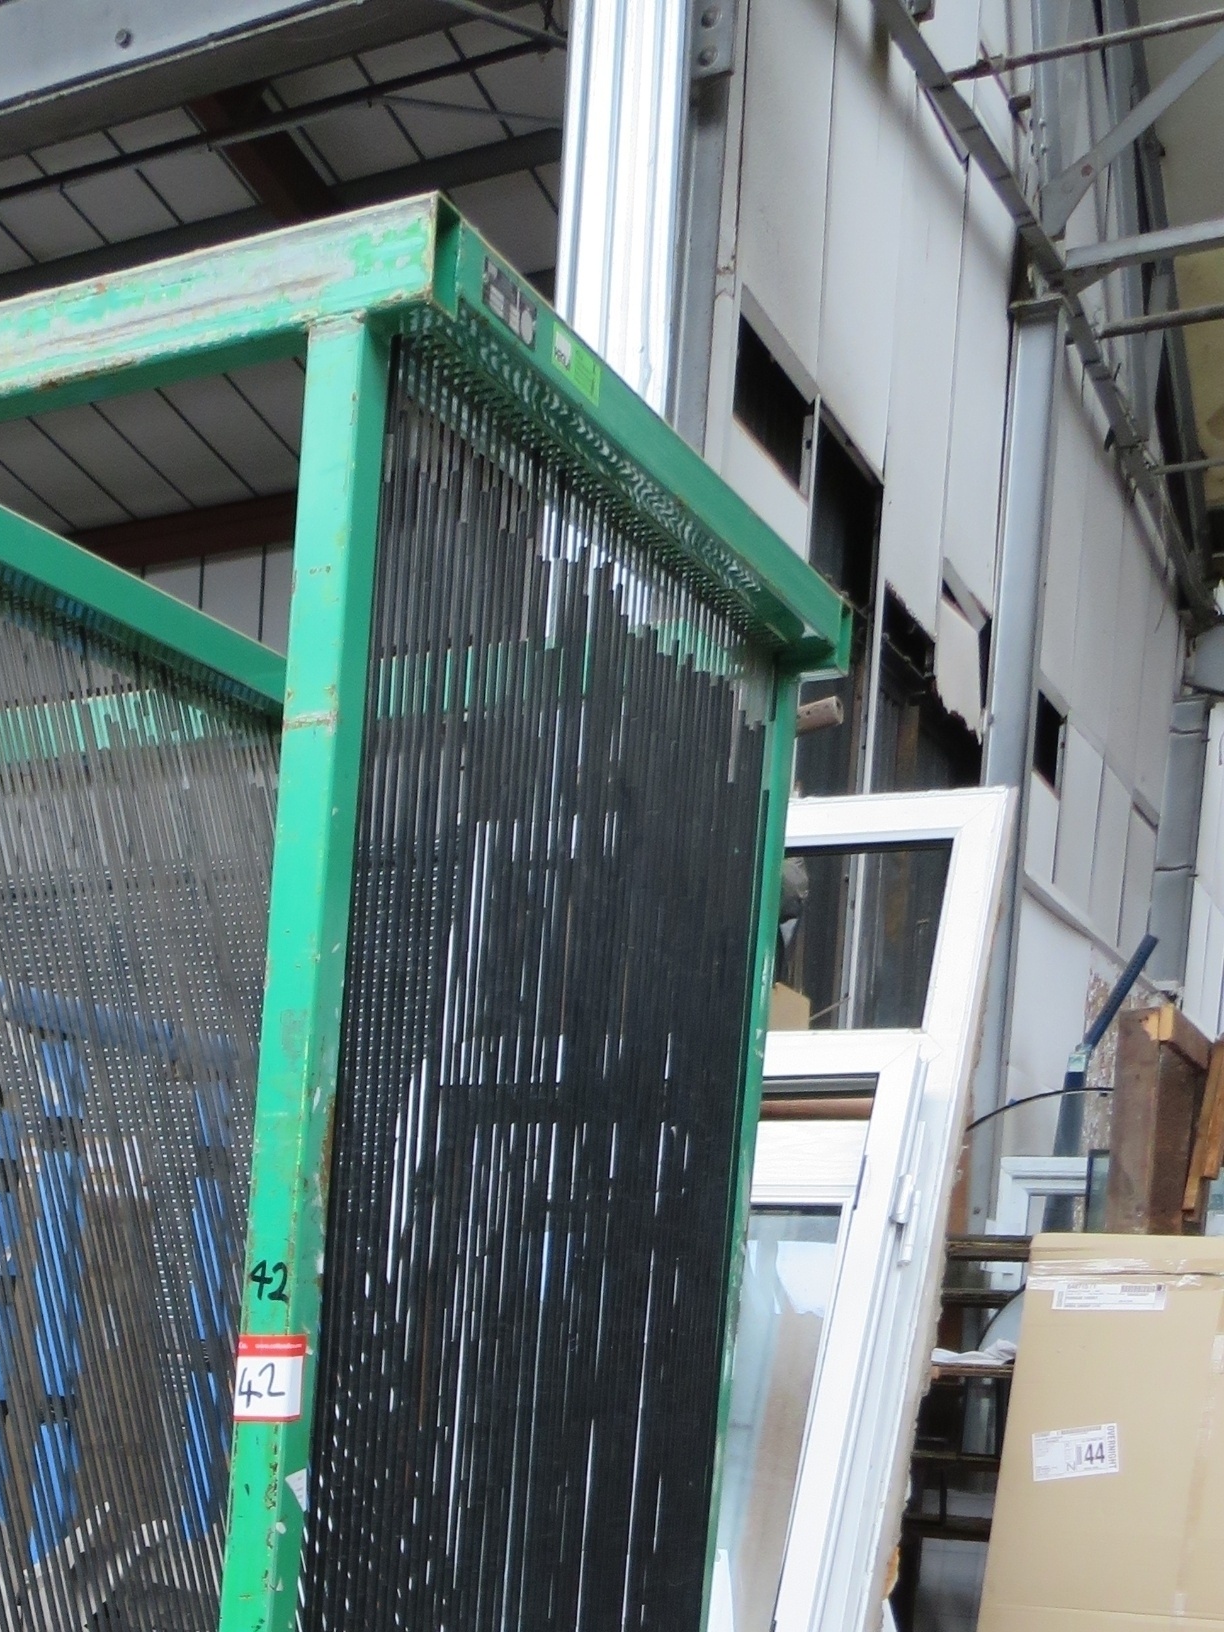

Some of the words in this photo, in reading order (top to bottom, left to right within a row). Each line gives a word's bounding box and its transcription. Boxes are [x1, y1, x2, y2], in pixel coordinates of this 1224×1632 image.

[250, 1260, 288, 1302] 42
[238, 1362, 285, 1408] 42
[1084, 1441, 1105, 1465] 44
[1107, 1425, 1117, 1469] OVERNIGHT
